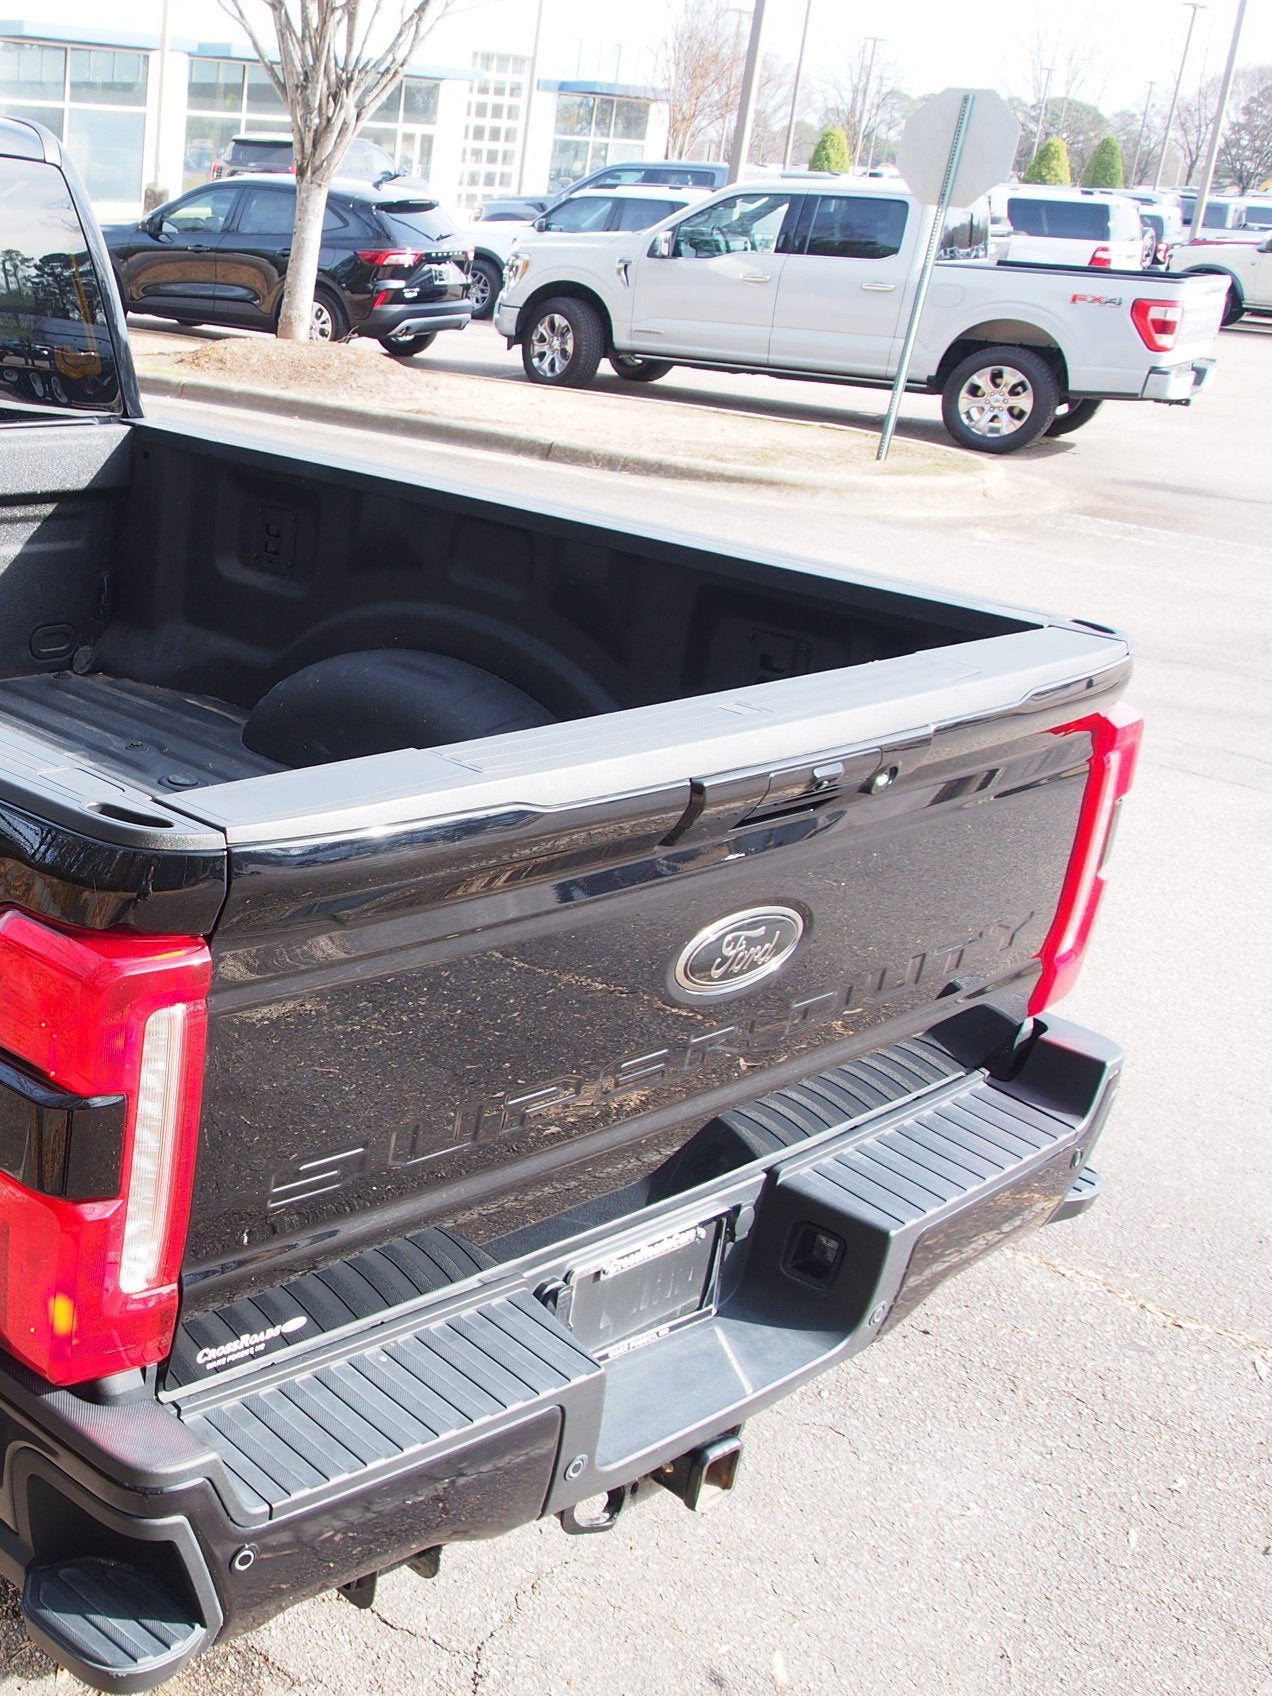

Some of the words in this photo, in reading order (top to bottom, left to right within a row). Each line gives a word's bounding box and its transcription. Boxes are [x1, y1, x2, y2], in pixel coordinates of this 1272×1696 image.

[1070, 294, 1122, 306] FX4
[710, 925, 781, 979] Ford
[266, 1014, 758, 1208] SUPER
[784, 910, 1035, 1037] DUTY
